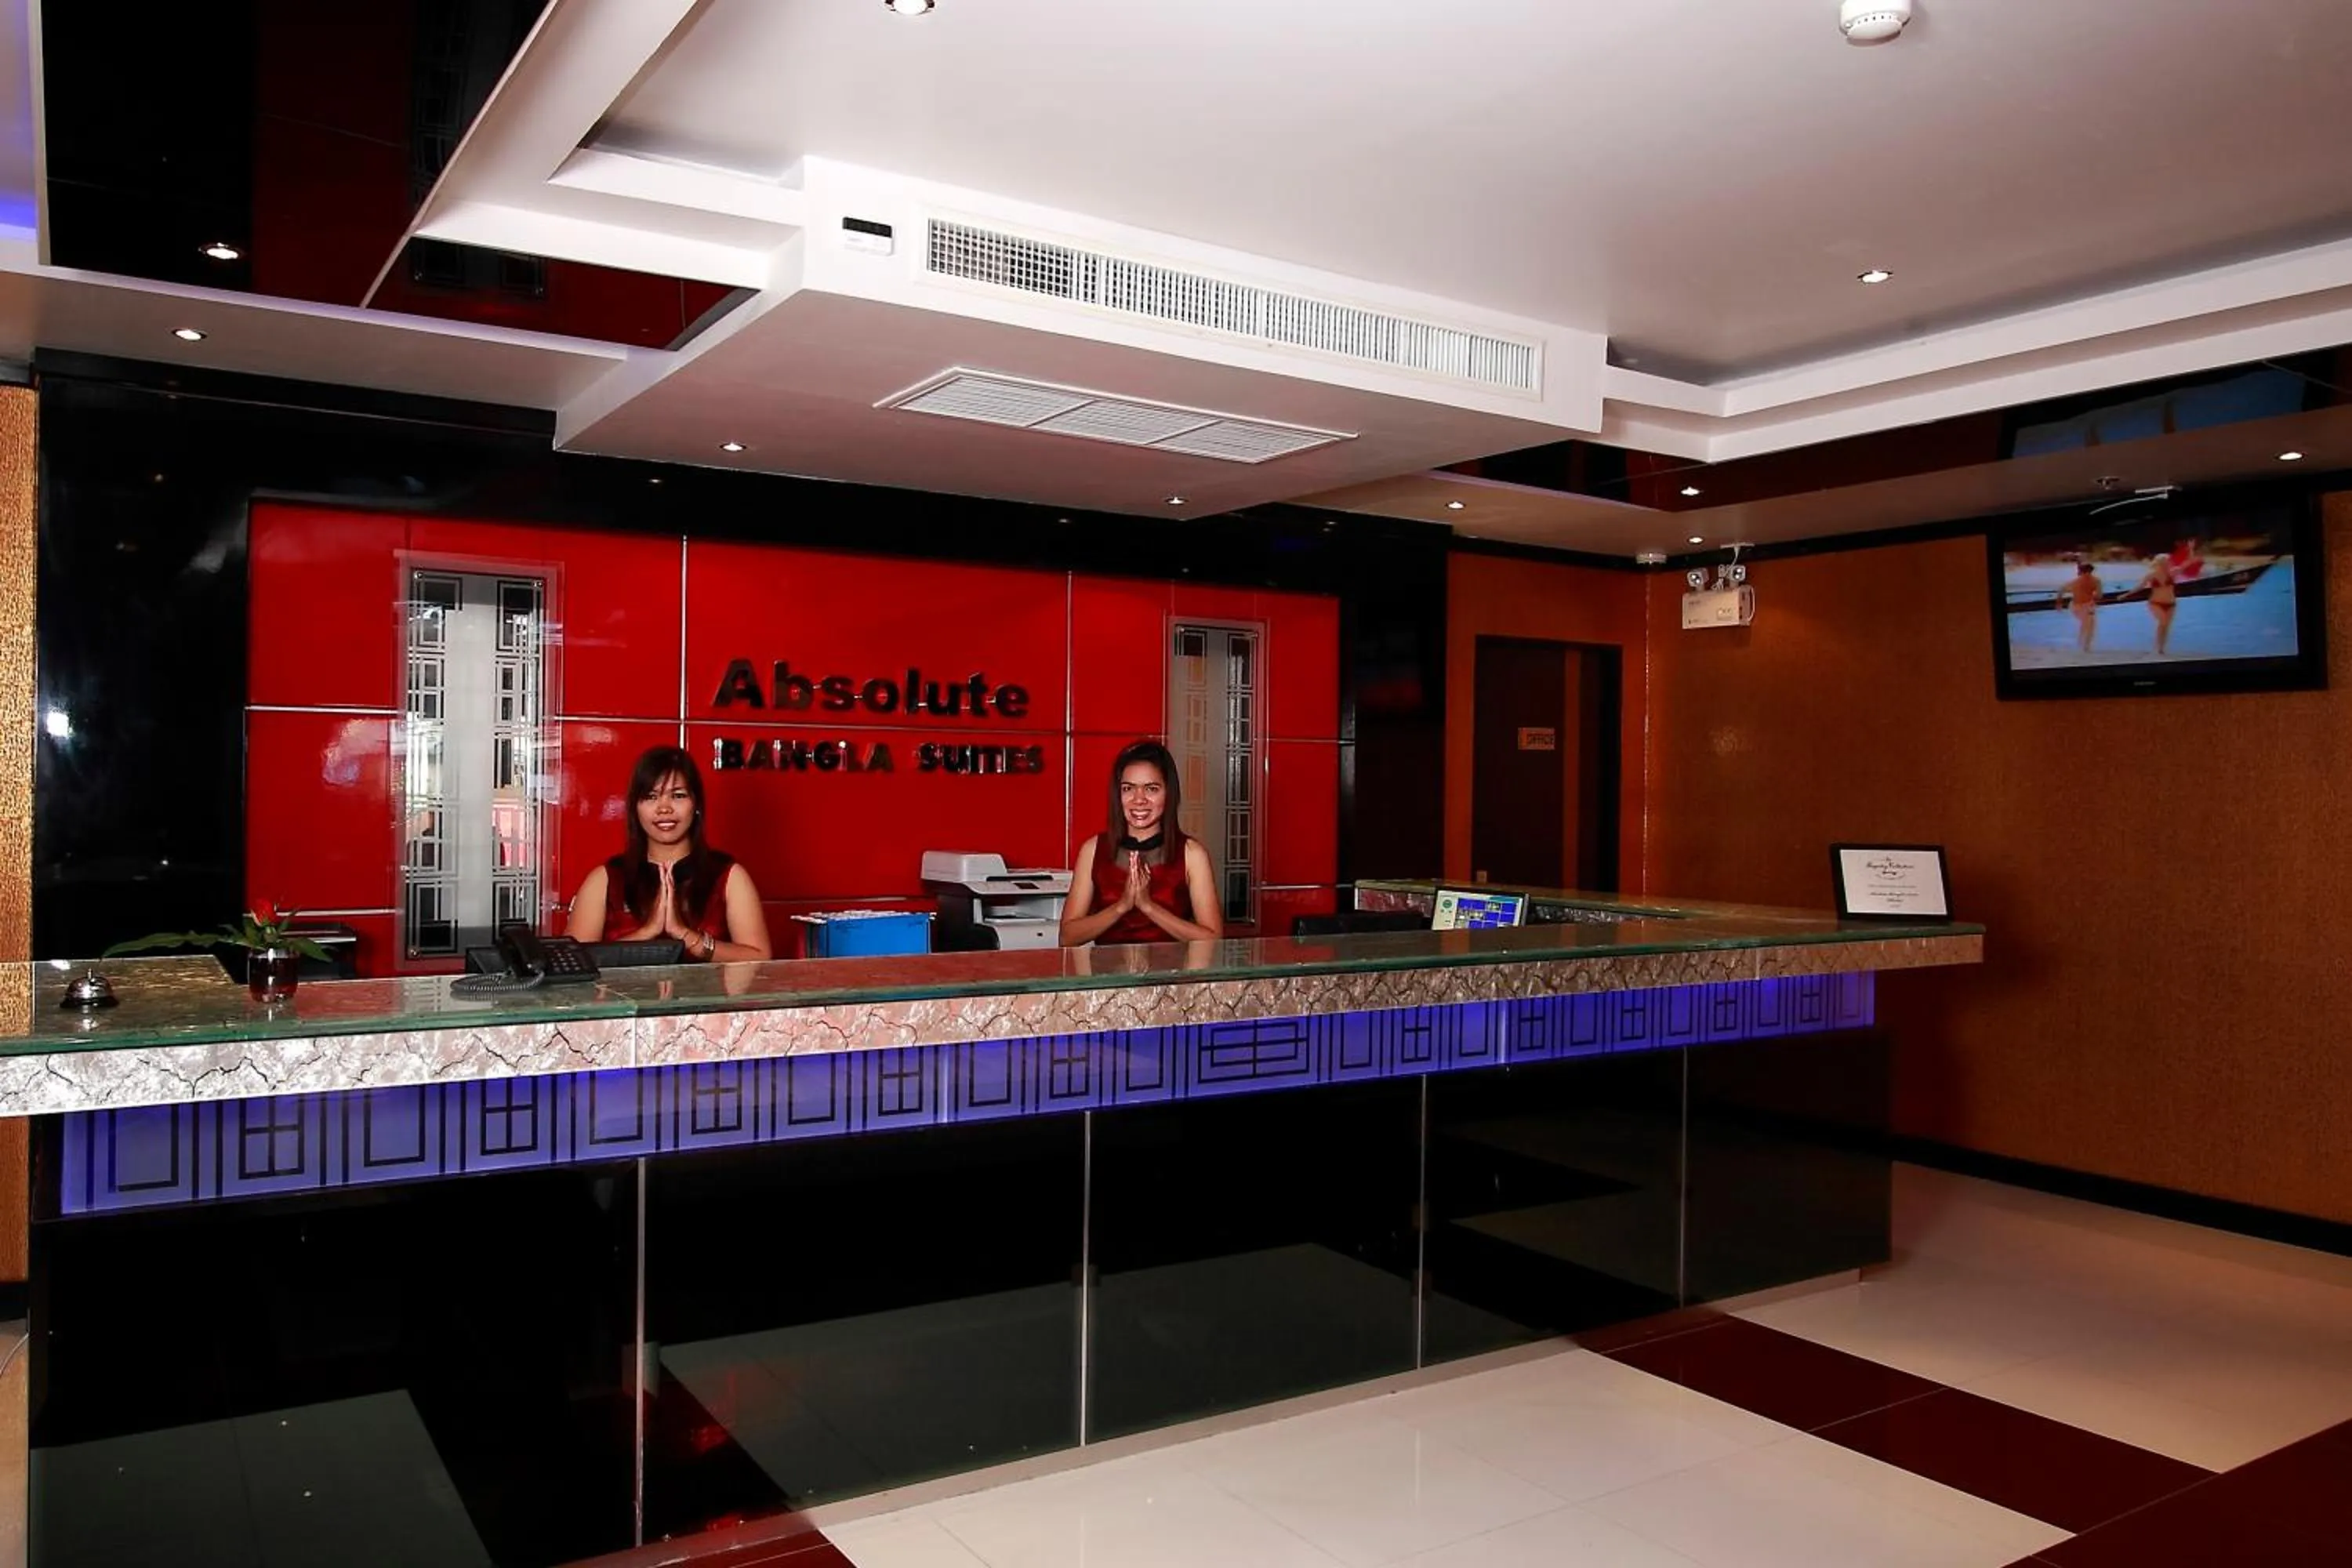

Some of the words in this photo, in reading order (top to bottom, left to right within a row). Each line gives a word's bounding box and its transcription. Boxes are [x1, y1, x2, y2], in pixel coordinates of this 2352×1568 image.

[711, 658, 1031, 719] Absolute
[713, 737, 895, 772] BANGLA
[915, 742, 1044, 775] SUITES
